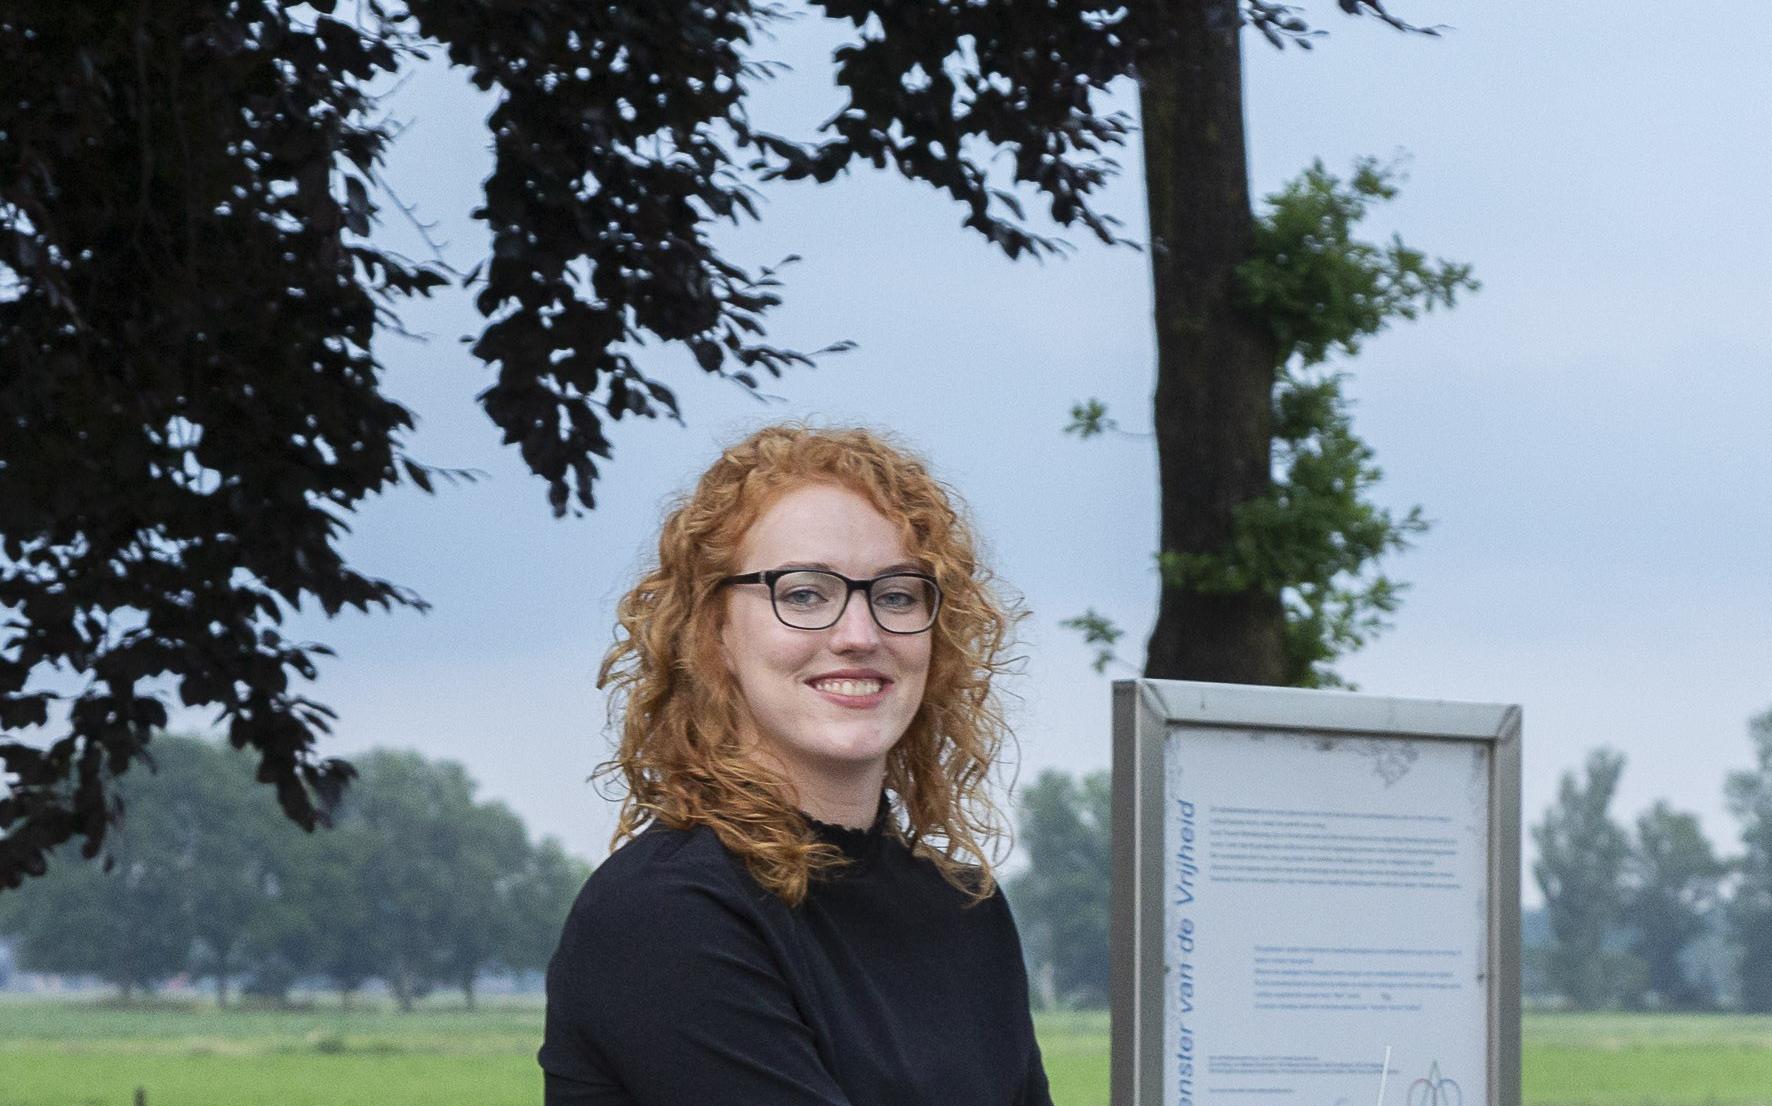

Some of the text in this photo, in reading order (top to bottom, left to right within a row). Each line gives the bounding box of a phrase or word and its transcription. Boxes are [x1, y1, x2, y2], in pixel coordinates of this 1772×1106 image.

[1175, 799, 1198, 905] Vrijheid
[1176, 918, 1194, 954] de
[1179, 962, 1194, 1014] van
